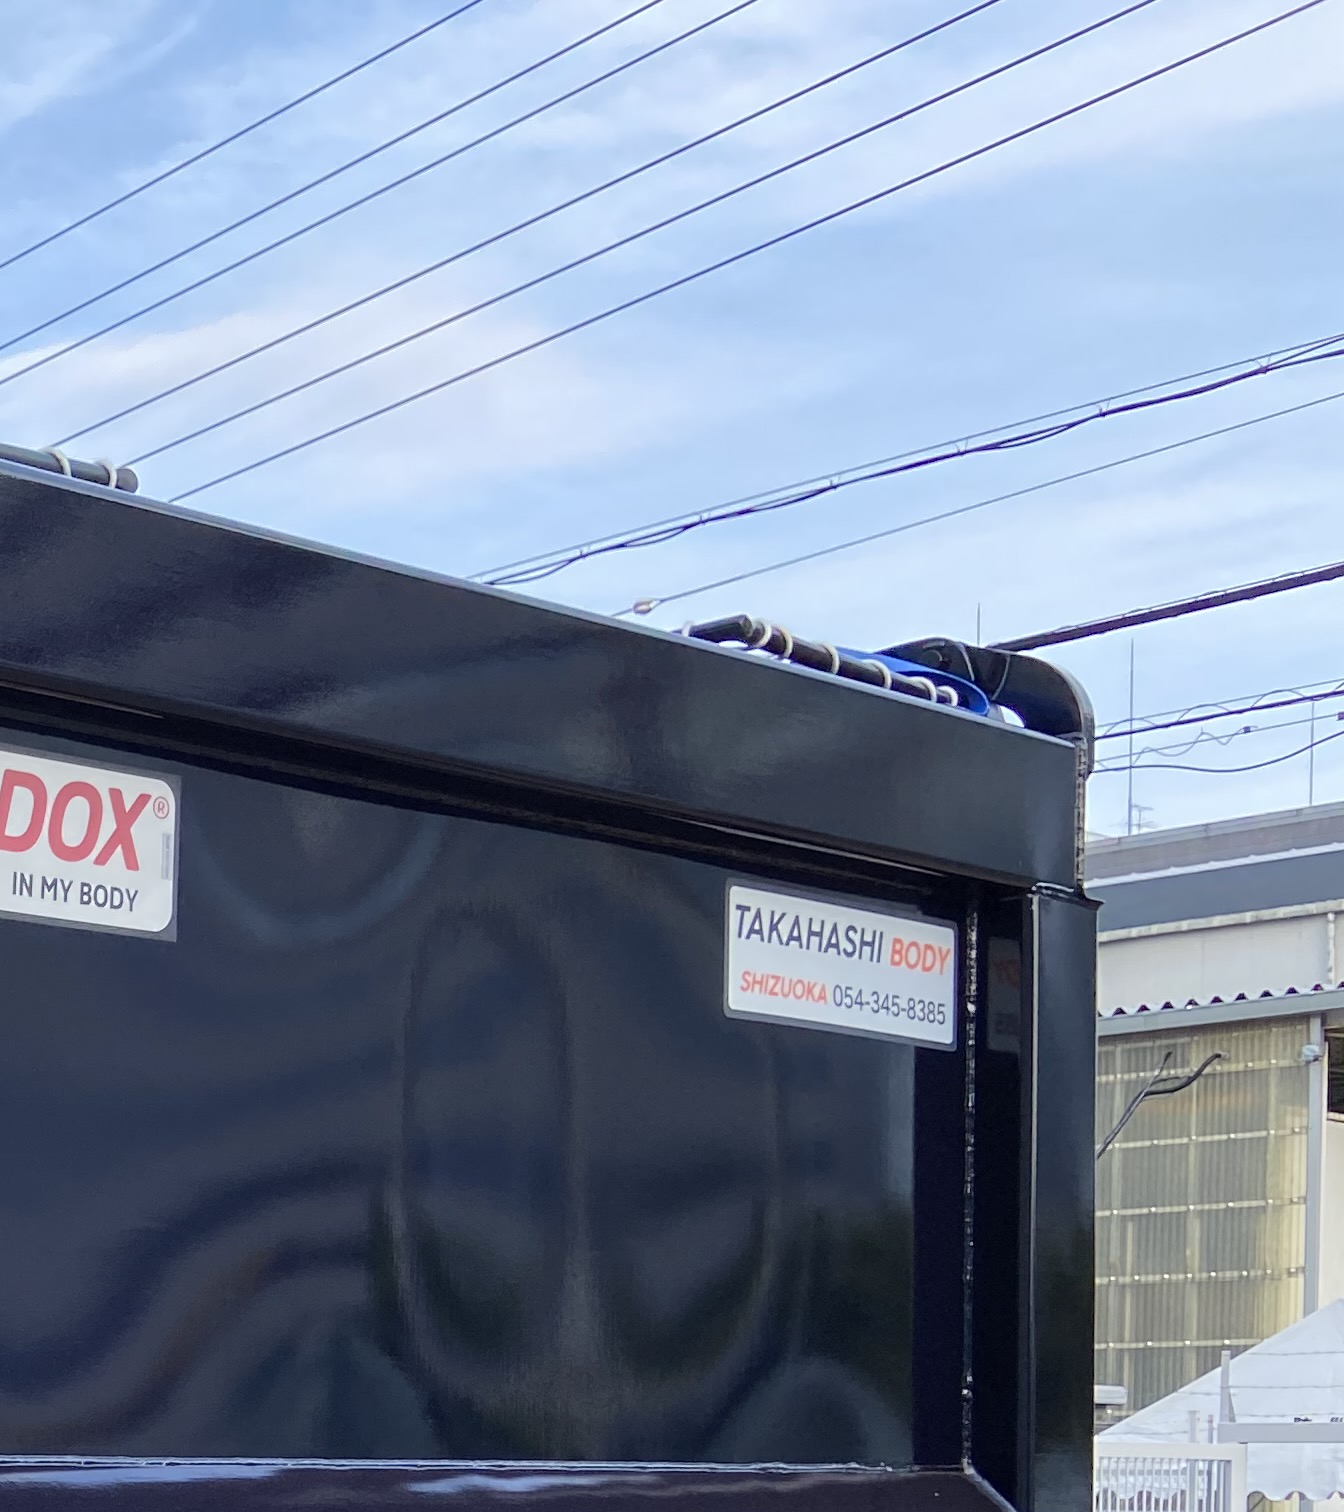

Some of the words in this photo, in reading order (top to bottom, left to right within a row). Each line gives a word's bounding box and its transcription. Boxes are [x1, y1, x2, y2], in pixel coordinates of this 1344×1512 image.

[12, 871, 34, 898] IN
[40, 876, 74, 903] MY
[79, 882, 139, 912] BODY
[735, 904, 884, 964] TAKAHASHI
[890, 937, 951, 976] BODY
[740, 970, 828, 1005] SHIZUOKA
[833, 984, 946, 1025] 054-345-8385
